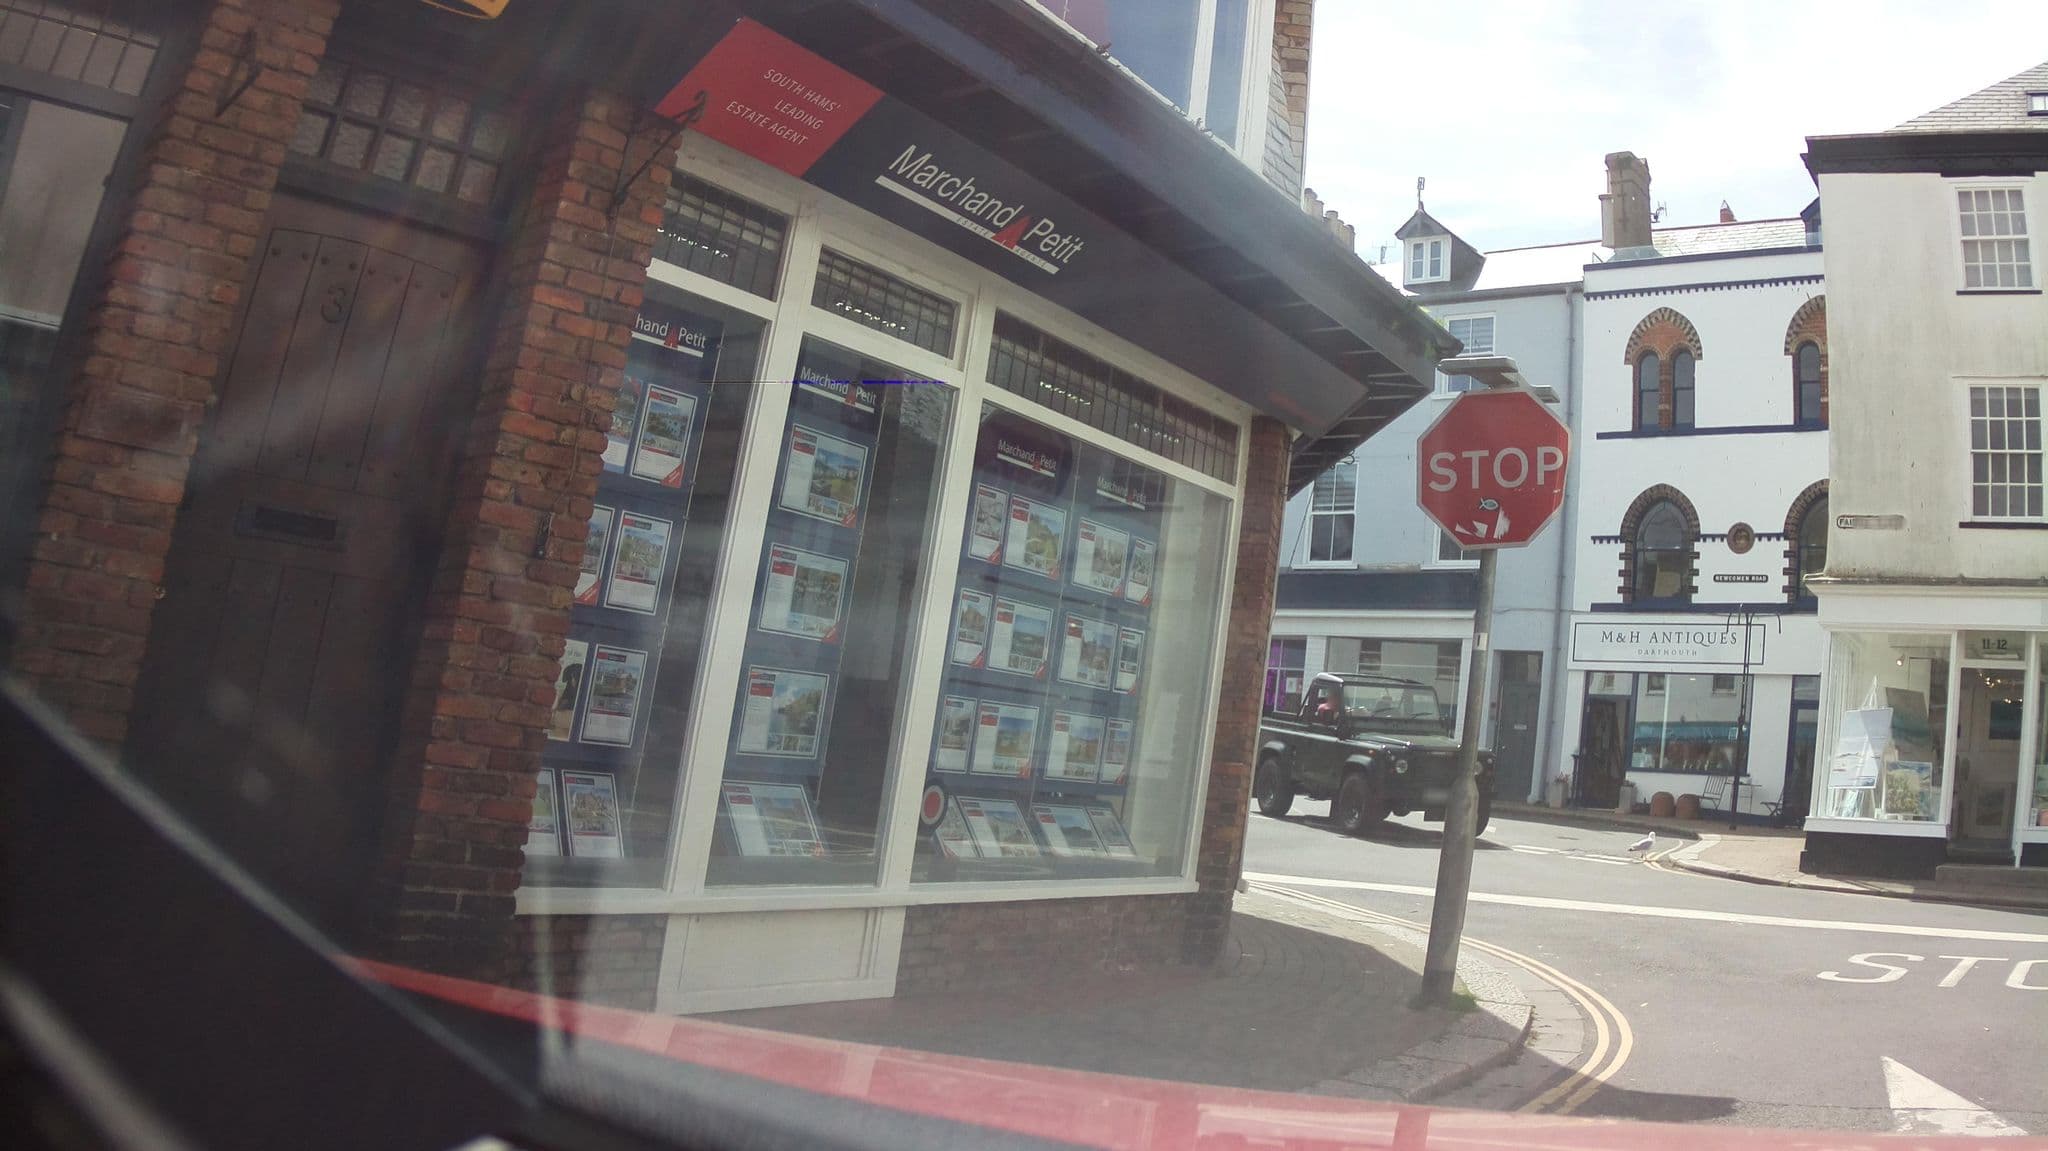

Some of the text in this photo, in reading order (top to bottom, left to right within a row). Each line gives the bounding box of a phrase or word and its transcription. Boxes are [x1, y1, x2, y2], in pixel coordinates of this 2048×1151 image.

[763, 69, 805, 95] SOUTH
[726, 101, 809, 145] ESTATE AGENT
[774, 99, 824, 130] LEADING
[888, 144, 1084, 264] Marchand Petit
[678, 327, 706, 349] Petit
[800, 366, 877, 405] Marchand Petit
[999, 439, 1036, 462] Marchand
[1428, 446, 1564, 492] STOP
[1601, 630, 1737, 648] M&H ANTIQUES
[1982, 637, 2008, 650] 11-12
[1637, 649, 1697, 657] DARTMOUTH
